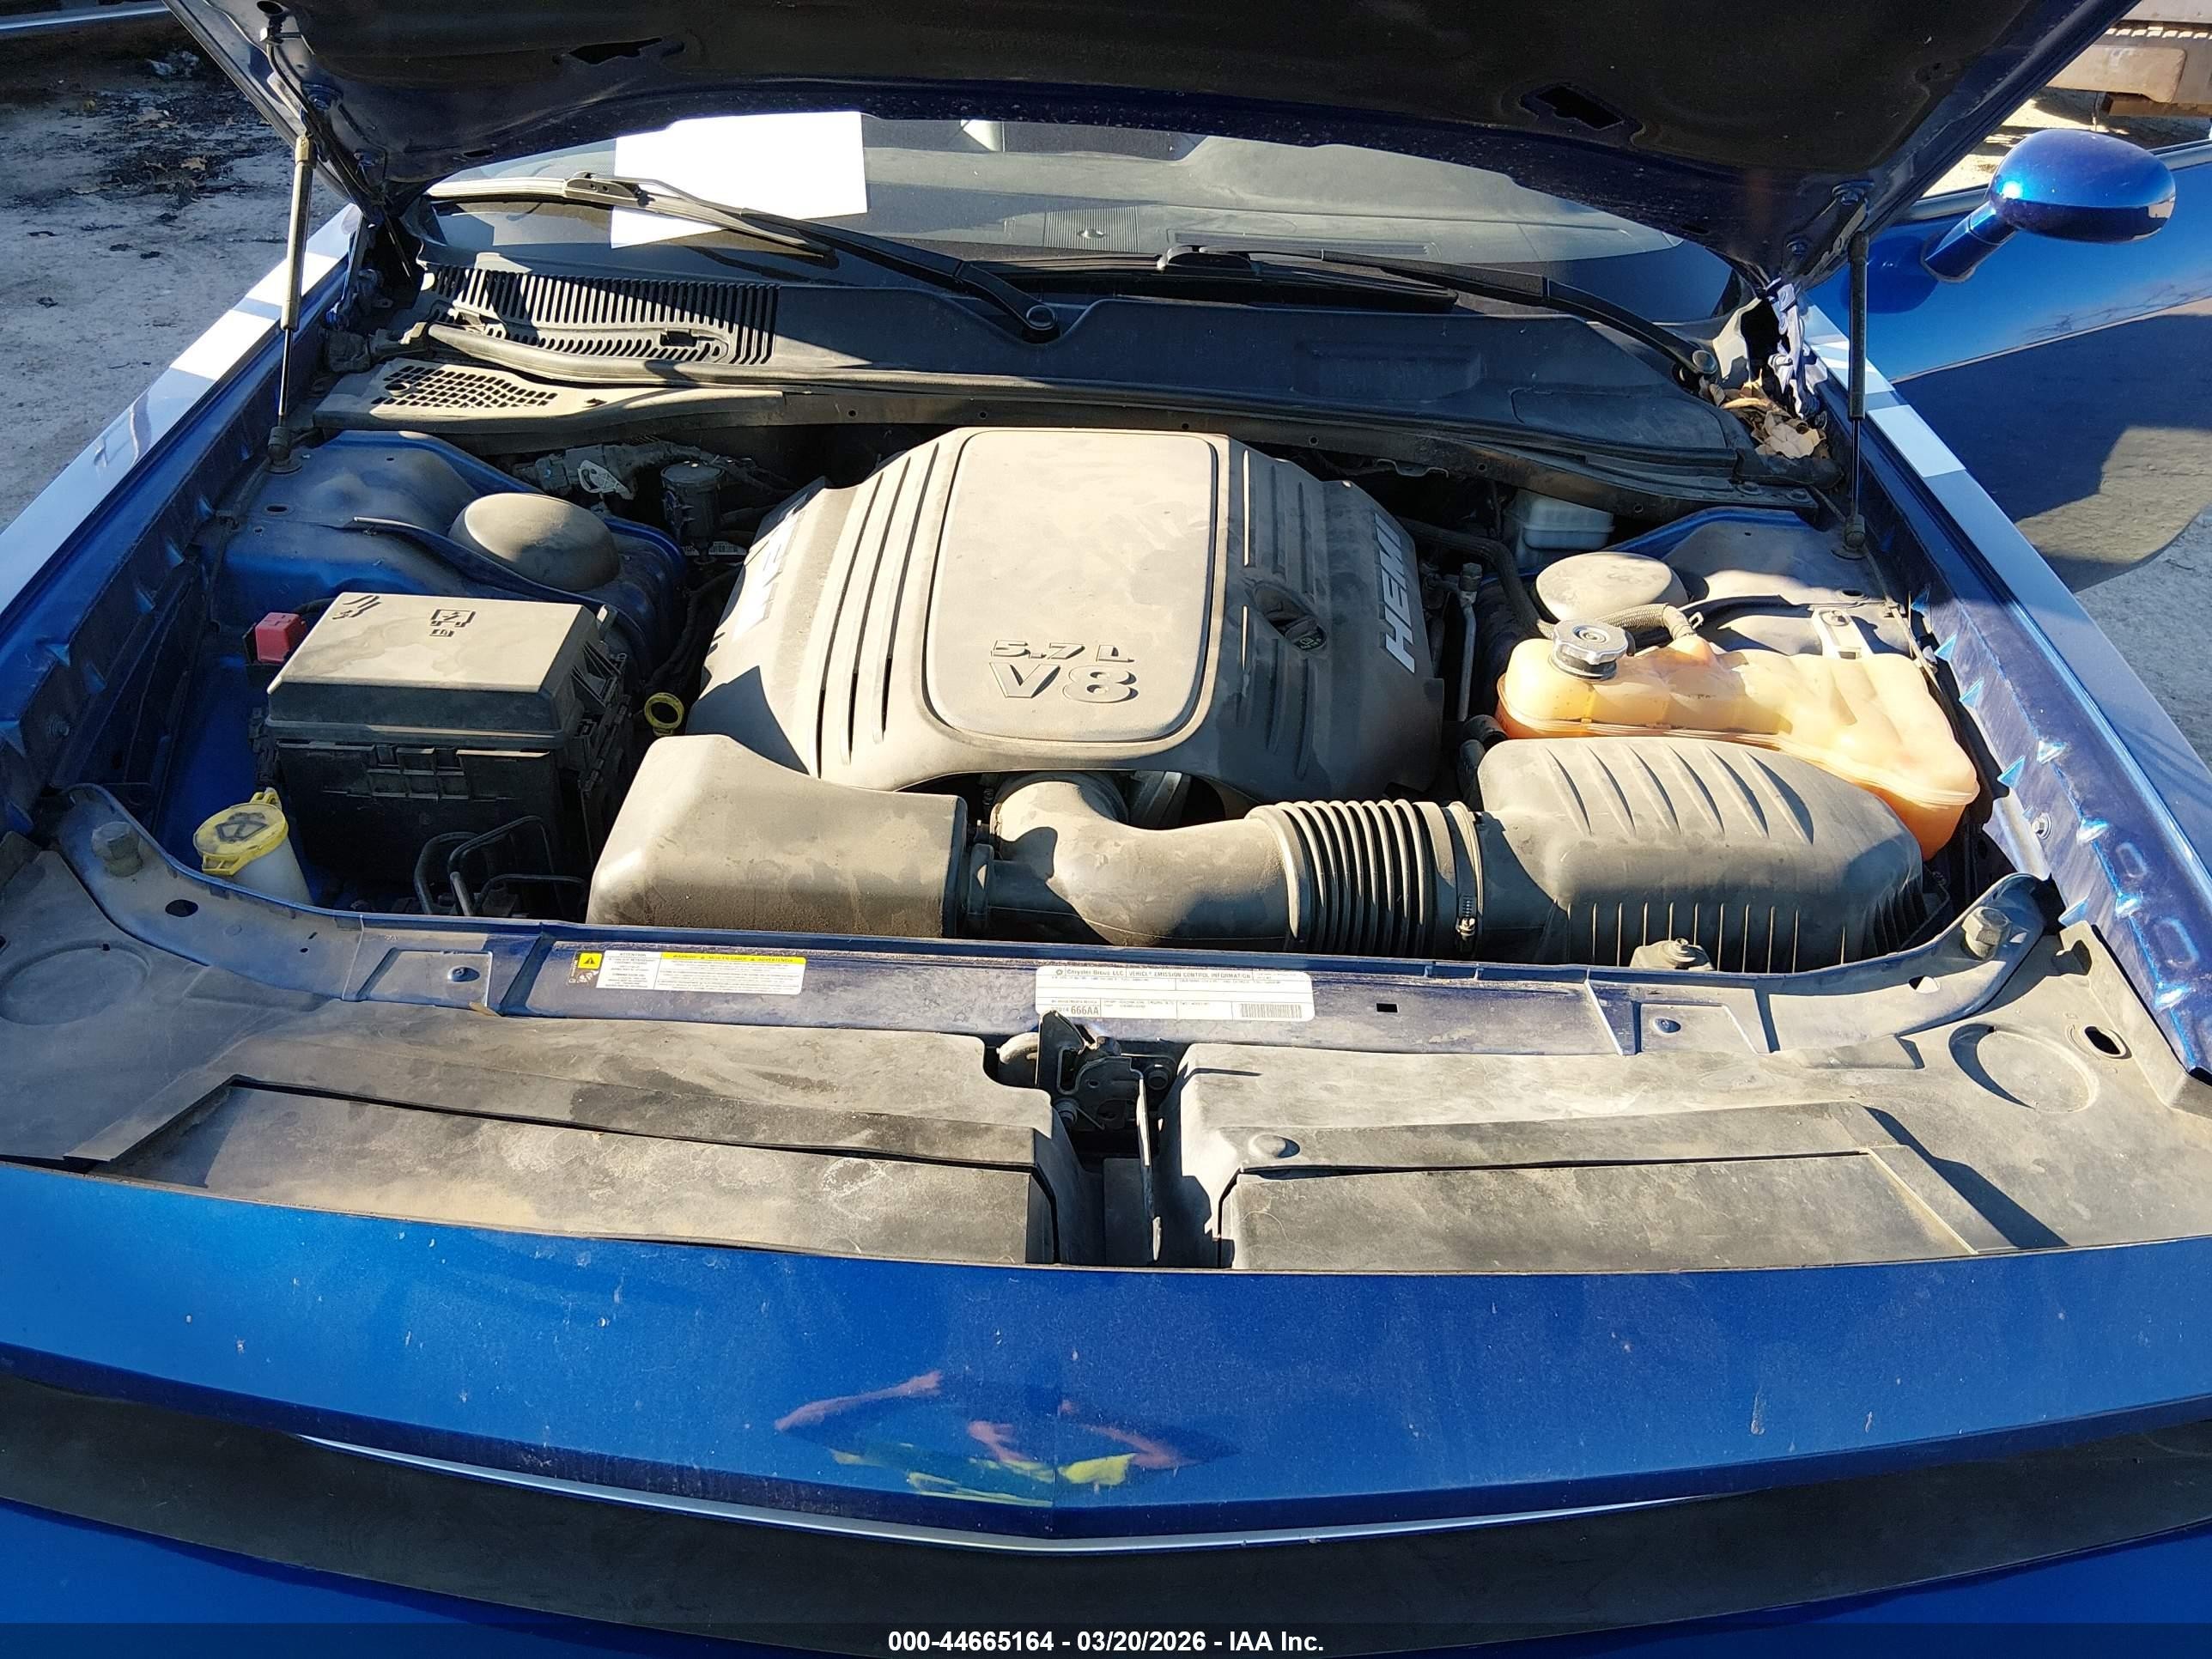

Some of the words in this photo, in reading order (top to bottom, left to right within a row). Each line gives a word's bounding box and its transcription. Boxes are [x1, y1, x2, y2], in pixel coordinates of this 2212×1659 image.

[1374, 513, 1416, 673] HEMI
[989, 662, 1139, 704] V8
[1071, 1006, 1099, 1016] 666AA
